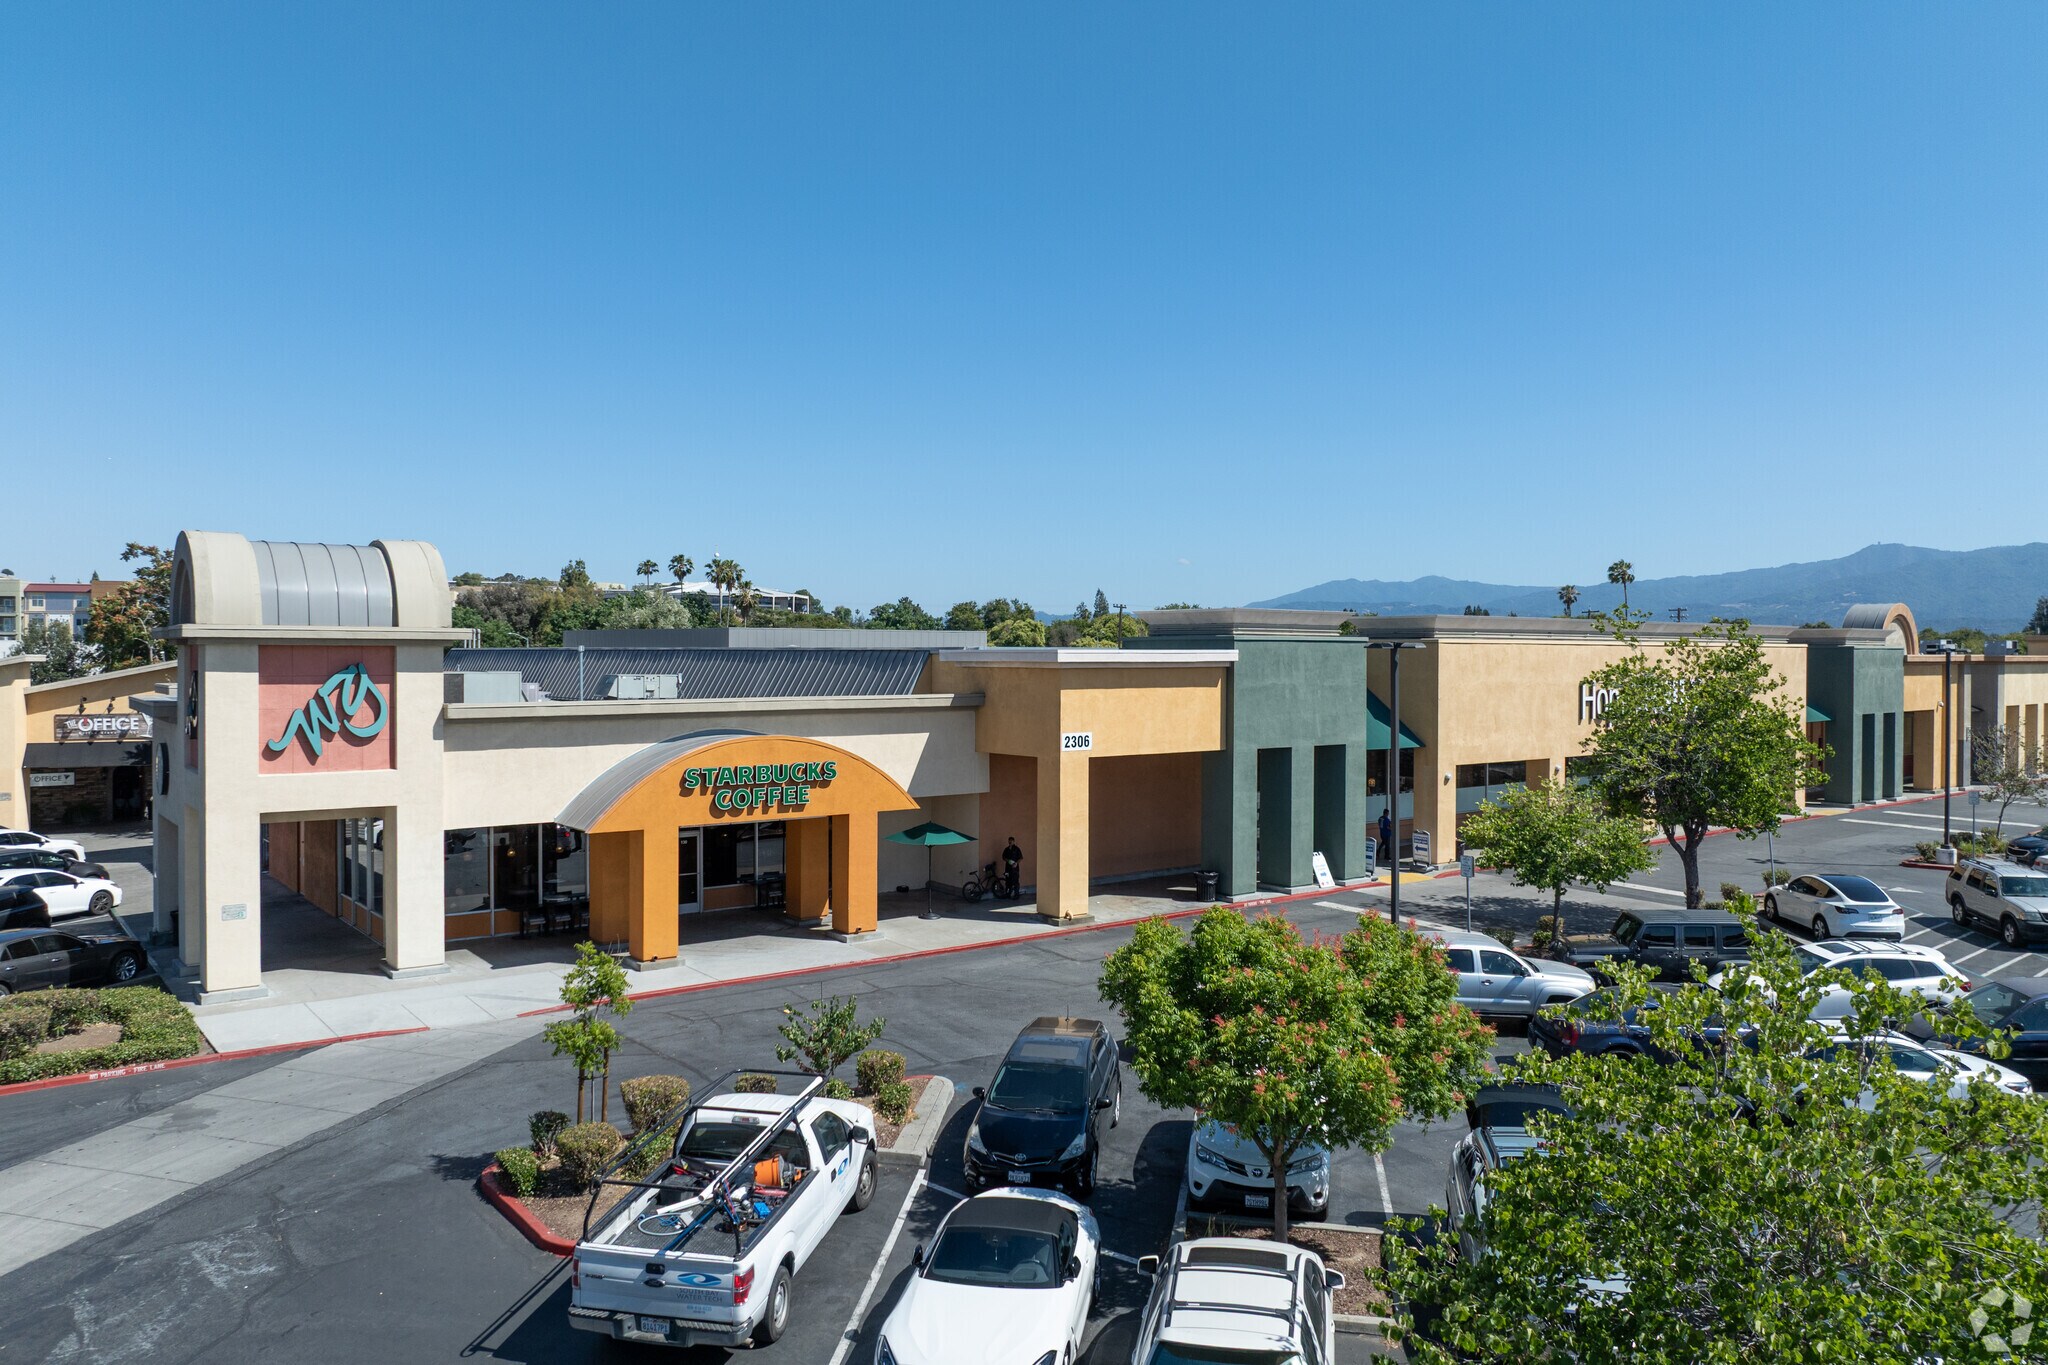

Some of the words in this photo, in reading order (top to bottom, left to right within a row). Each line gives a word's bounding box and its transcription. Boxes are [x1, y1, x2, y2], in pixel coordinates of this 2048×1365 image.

[78, 717, 139, 731] OFFICE
[1064, 735, 1090, 748] 2306
[685, 761, 837, 788] STARBUCKS
[715, 785, 810, 810] COFFEE
[100, 1069, 125, 1077] PARKING
[676, 1293, 702, 1301] WATER
[679, 1287, 703, 1295] SOUTH
